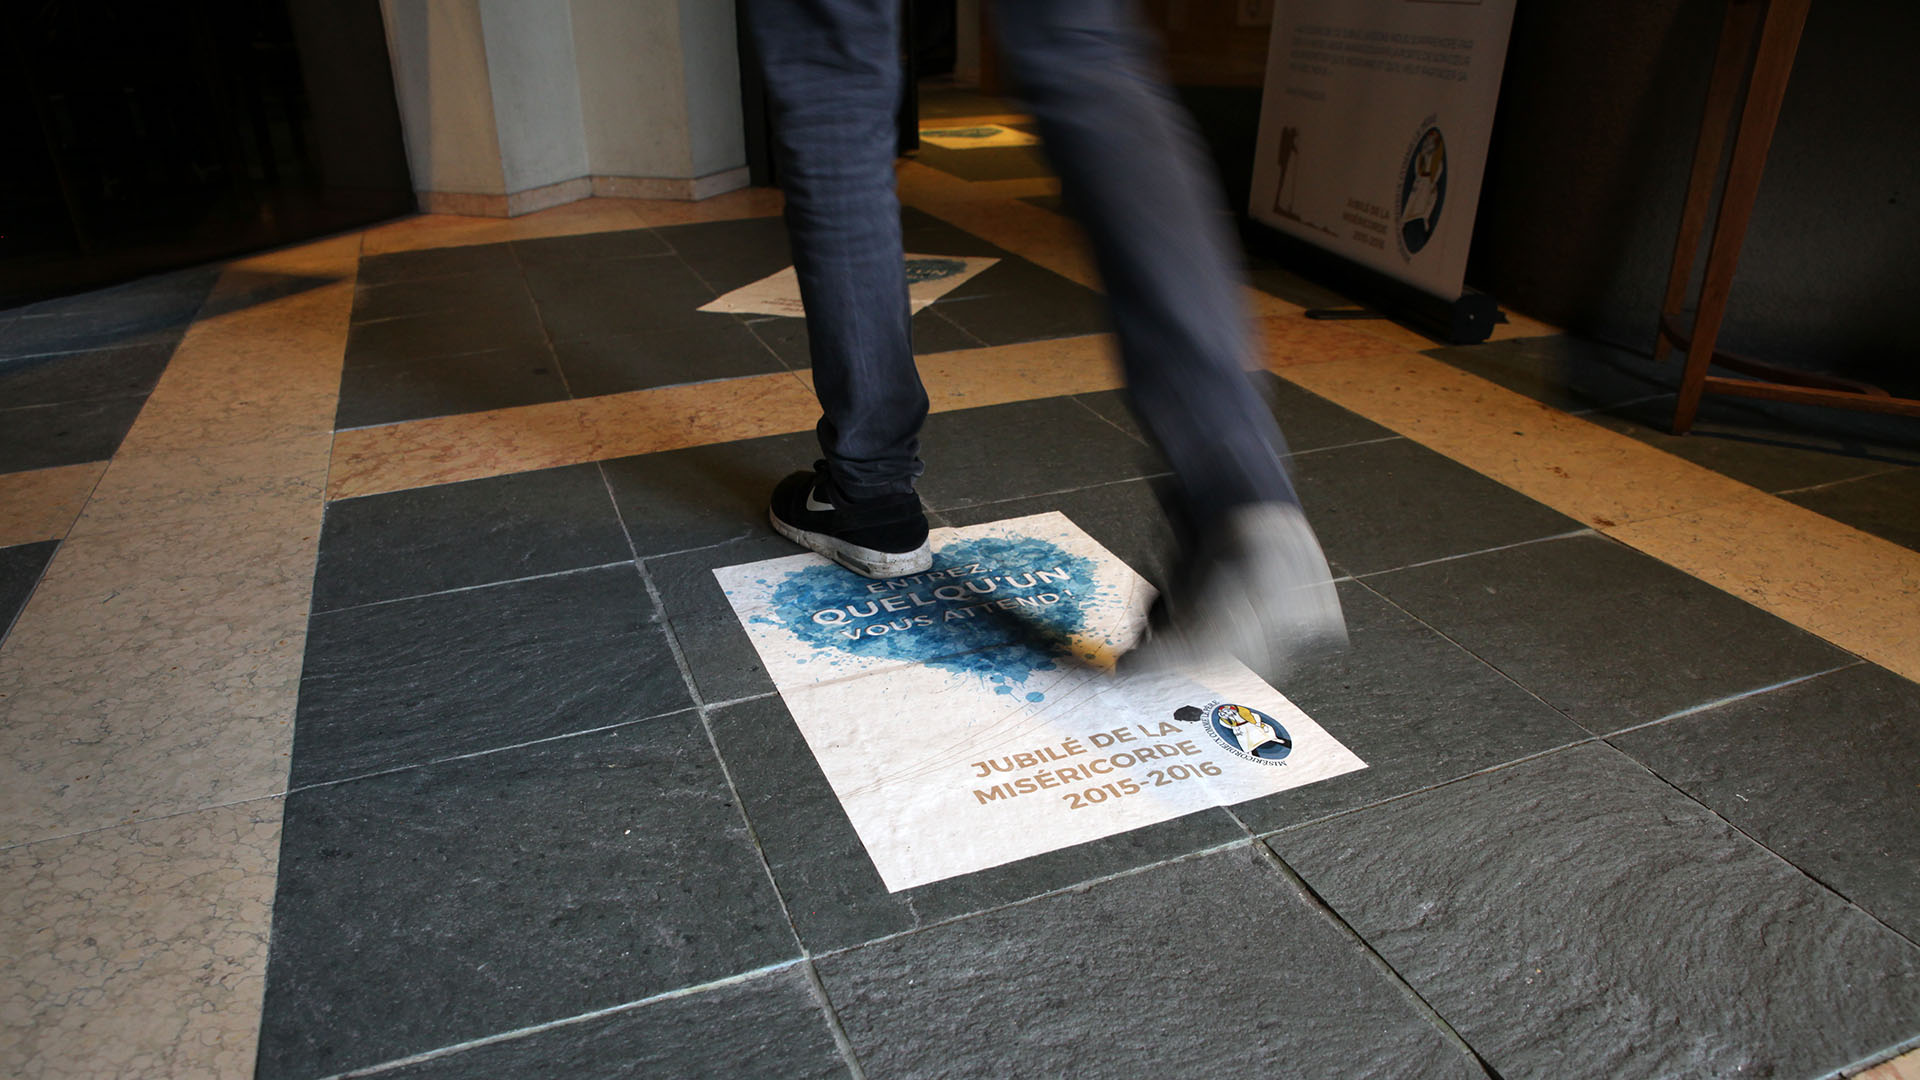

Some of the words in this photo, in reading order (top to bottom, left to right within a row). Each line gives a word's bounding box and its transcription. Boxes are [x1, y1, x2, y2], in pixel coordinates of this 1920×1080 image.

[812, 567, 1071, 626] QUELQU'UN
[840, 615, 934, 641] VOUS
[972, 737, 1088, 778] JUBILÉ
[1088, 727, 1138, 748] DE
[1137, 721, 1184, 738] LA
[973, 740, 1203, 805] MISÉRICORDE
[1062, 761, 1223, 810] 2015-2016
